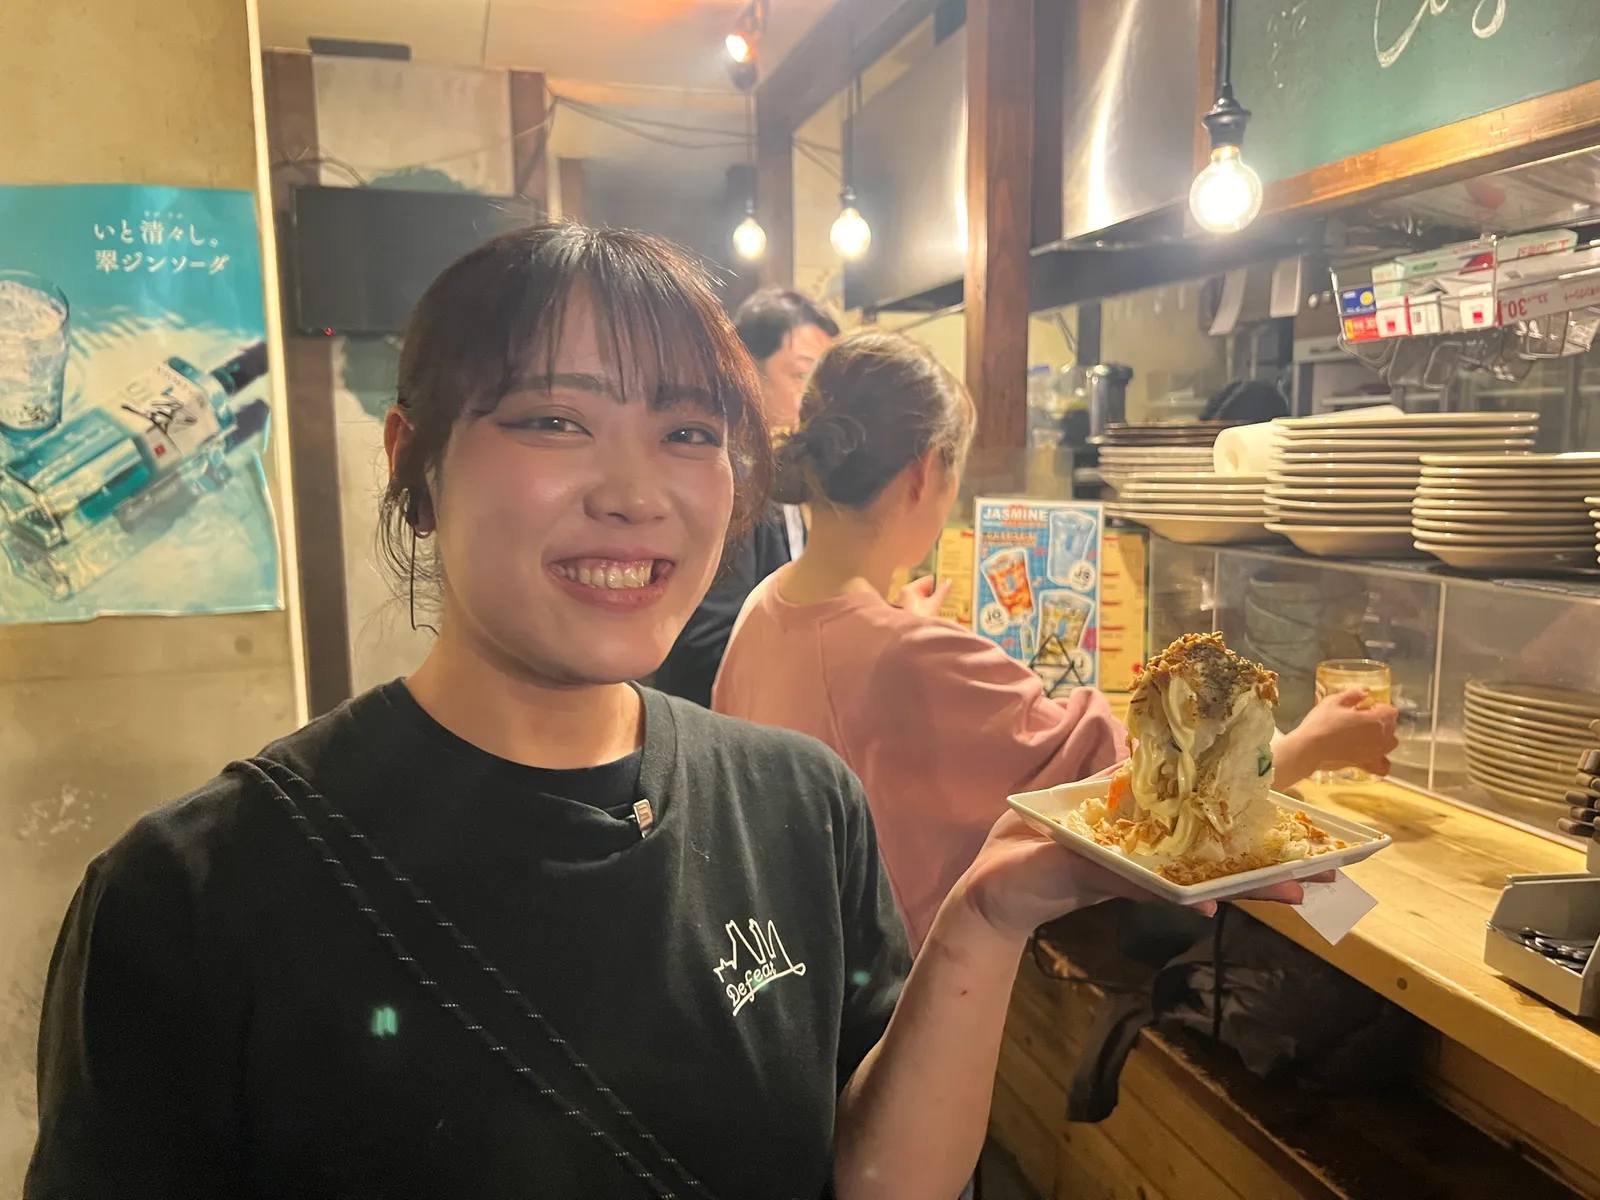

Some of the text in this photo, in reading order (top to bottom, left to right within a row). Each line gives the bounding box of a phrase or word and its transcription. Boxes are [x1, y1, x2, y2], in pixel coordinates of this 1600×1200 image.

[93, 218, 219, 248] いと清々し。
[94, 249, 230, 275] 翠ジンソーダ
[983, 507, 1049, 522] JASMINE
[726, 960, 776, 1008] Defeat
